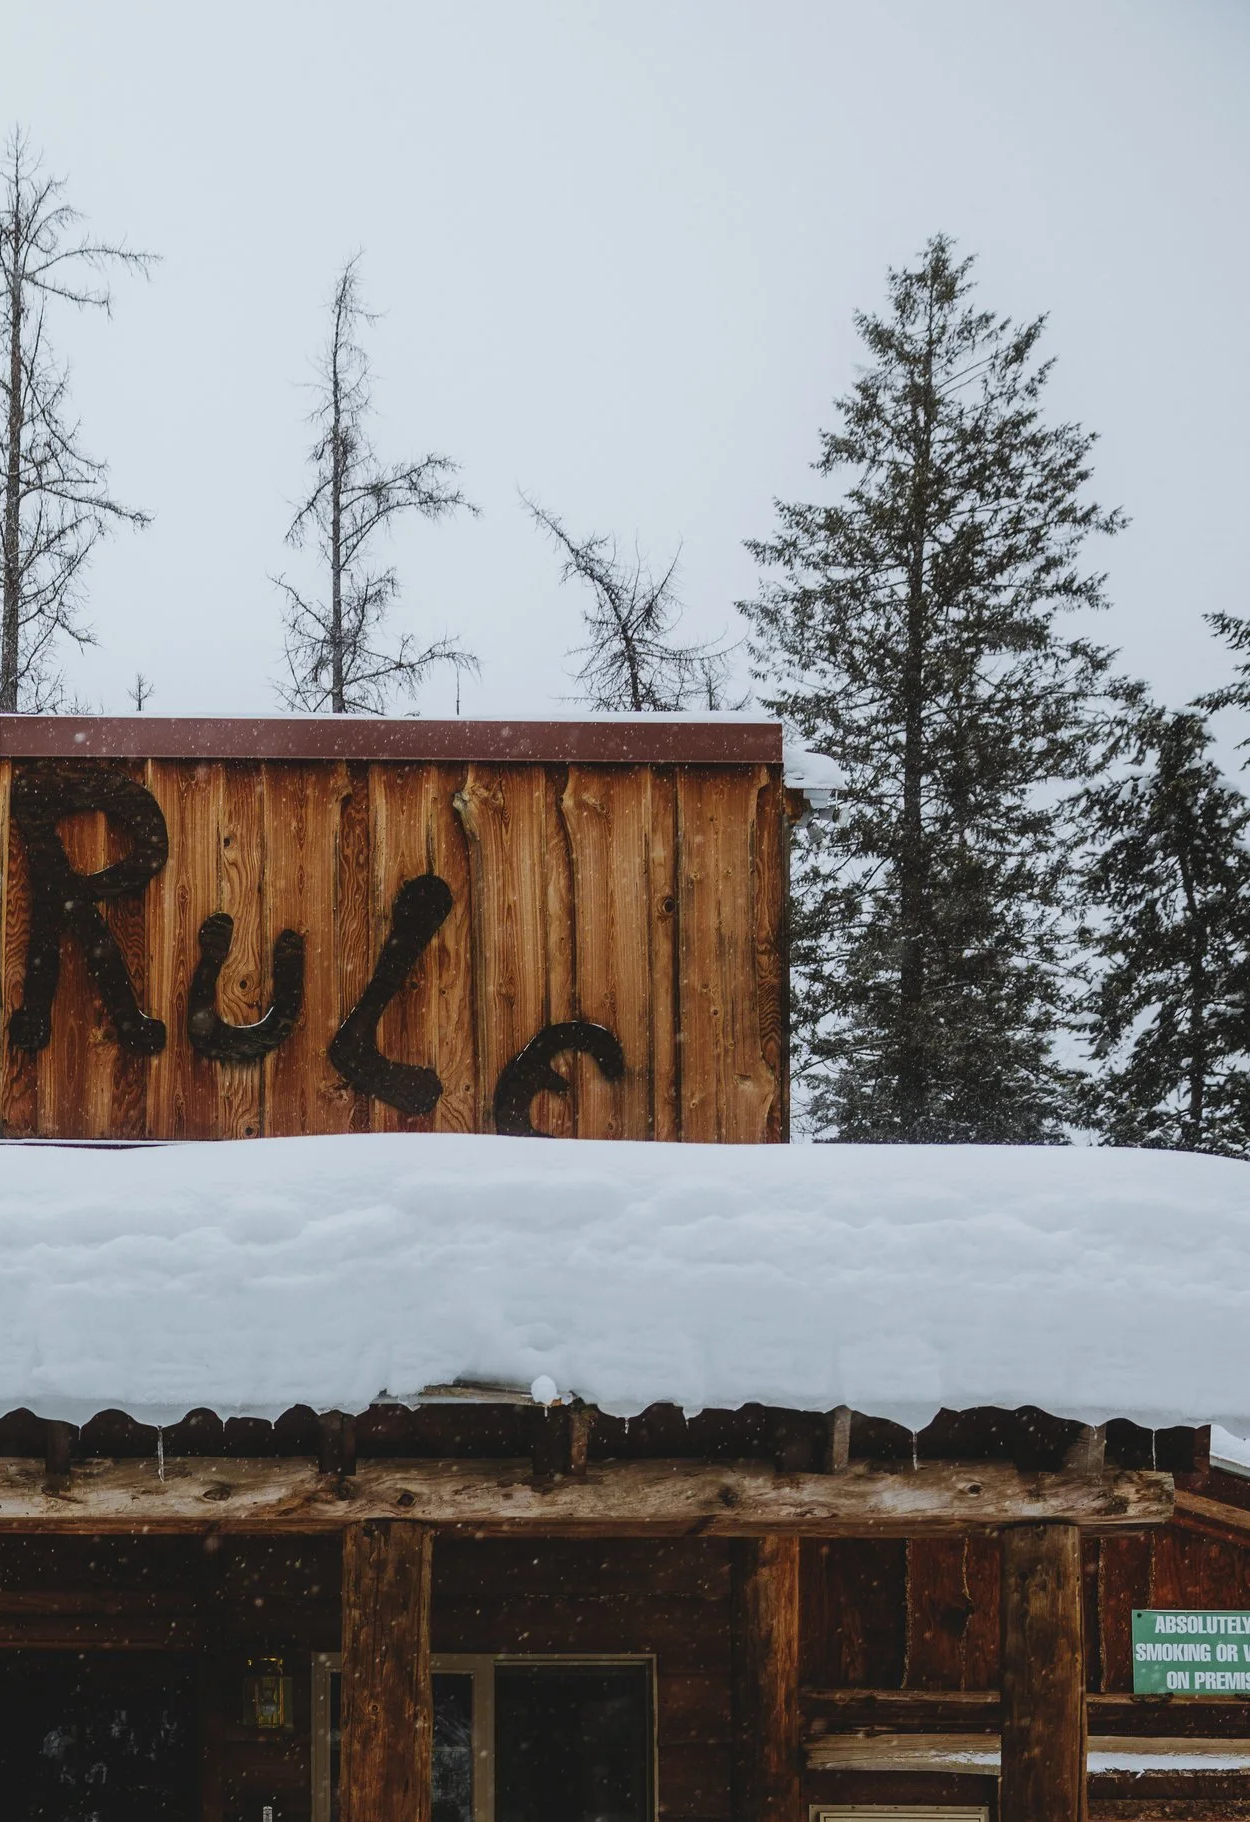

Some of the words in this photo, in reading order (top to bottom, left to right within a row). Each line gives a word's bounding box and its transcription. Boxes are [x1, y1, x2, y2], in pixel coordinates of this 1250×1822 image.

[1154, 1615, 1250, 1634] ABSOLUTELY
[1135, 1643, 1211, 1661] SMOKING
[1216, 1643, 1238, 1661] OR
[1166, 1671, 1189, 1689] ON
